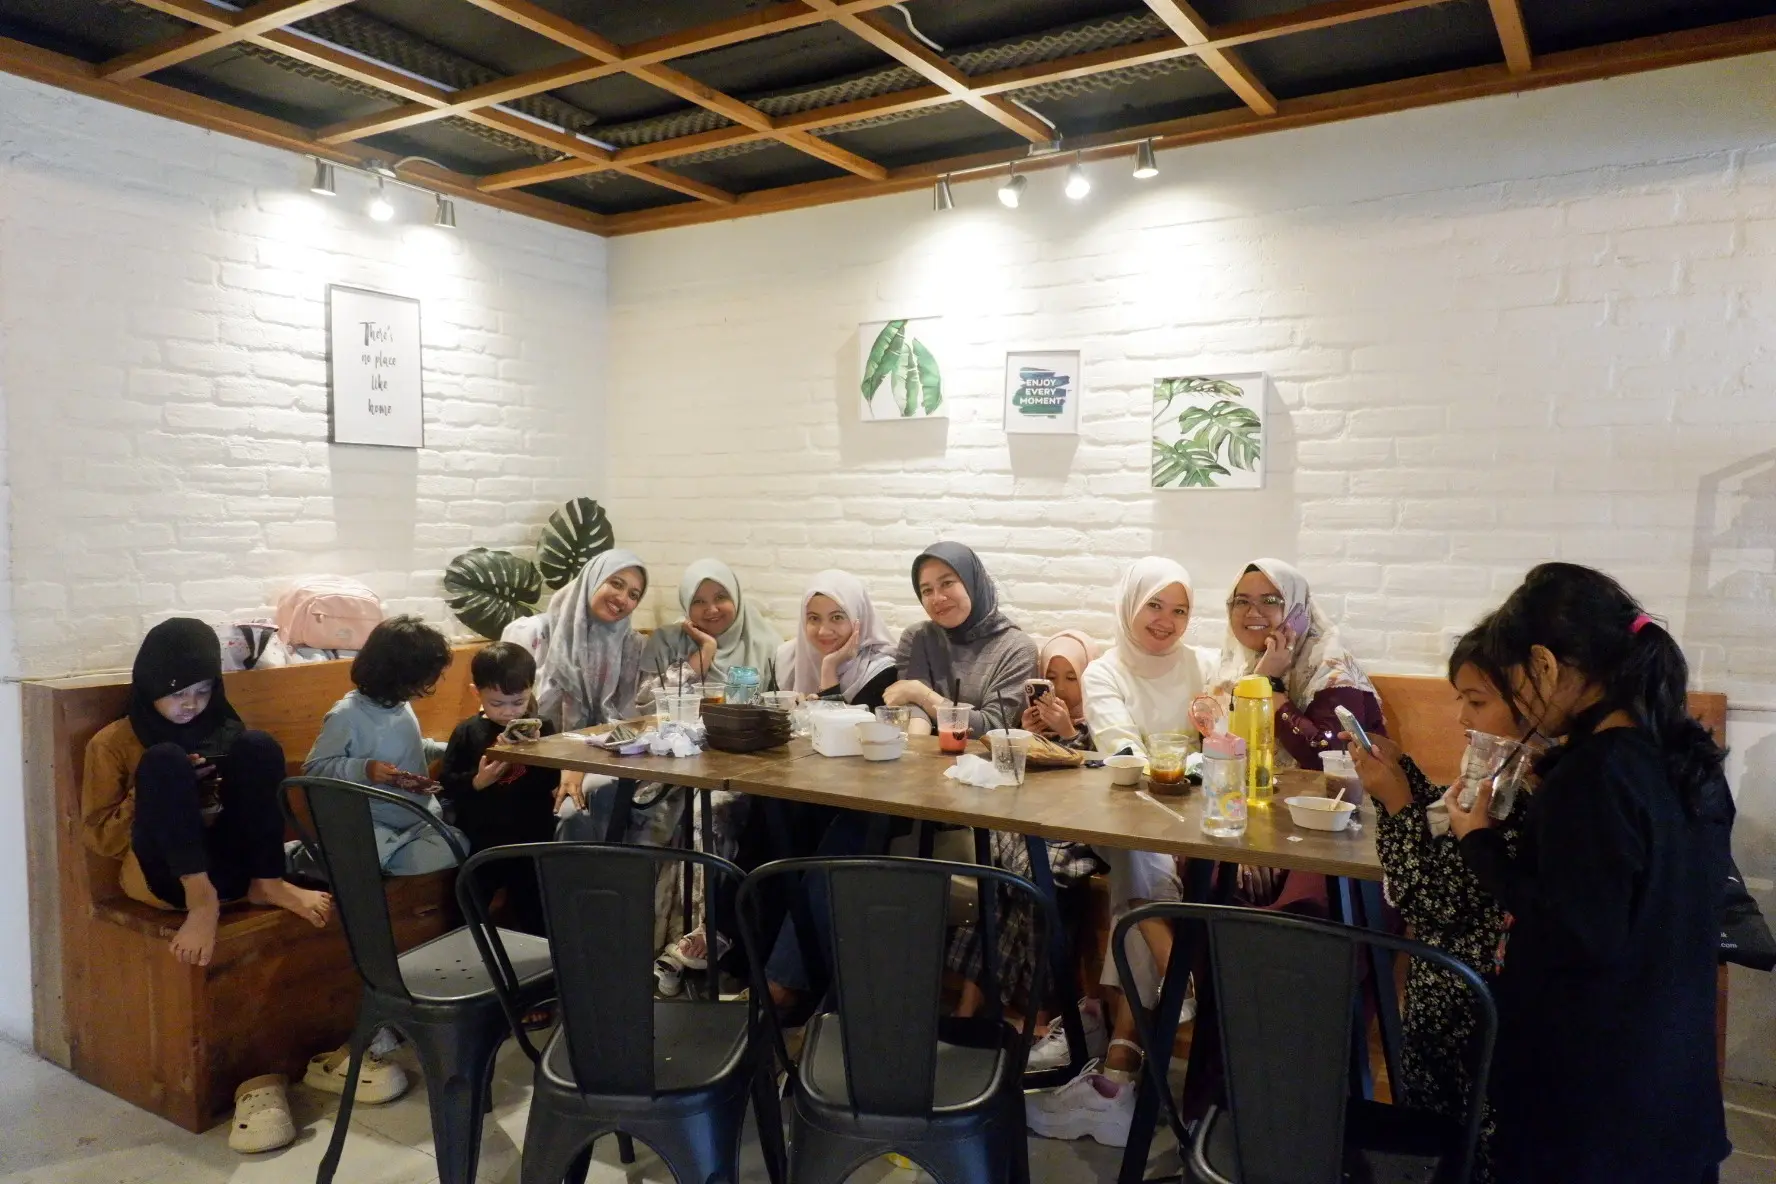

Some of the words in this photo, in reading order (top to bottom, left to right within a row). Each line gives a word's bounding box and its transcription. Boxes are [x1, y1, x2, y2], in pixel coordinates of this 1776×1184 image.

[359, 321, 394, 347] There's
[361, 353, 371, 365] no
[375, 349, 396, 369] place
[371, 373, 388, 391] like
[1026, 379, 1057, 387] ENJOY
[1025, 388, 1057, 396] EVERY
[368, 398, 392, 415] home
[1019, 397, 1062, 405] MOMENT
